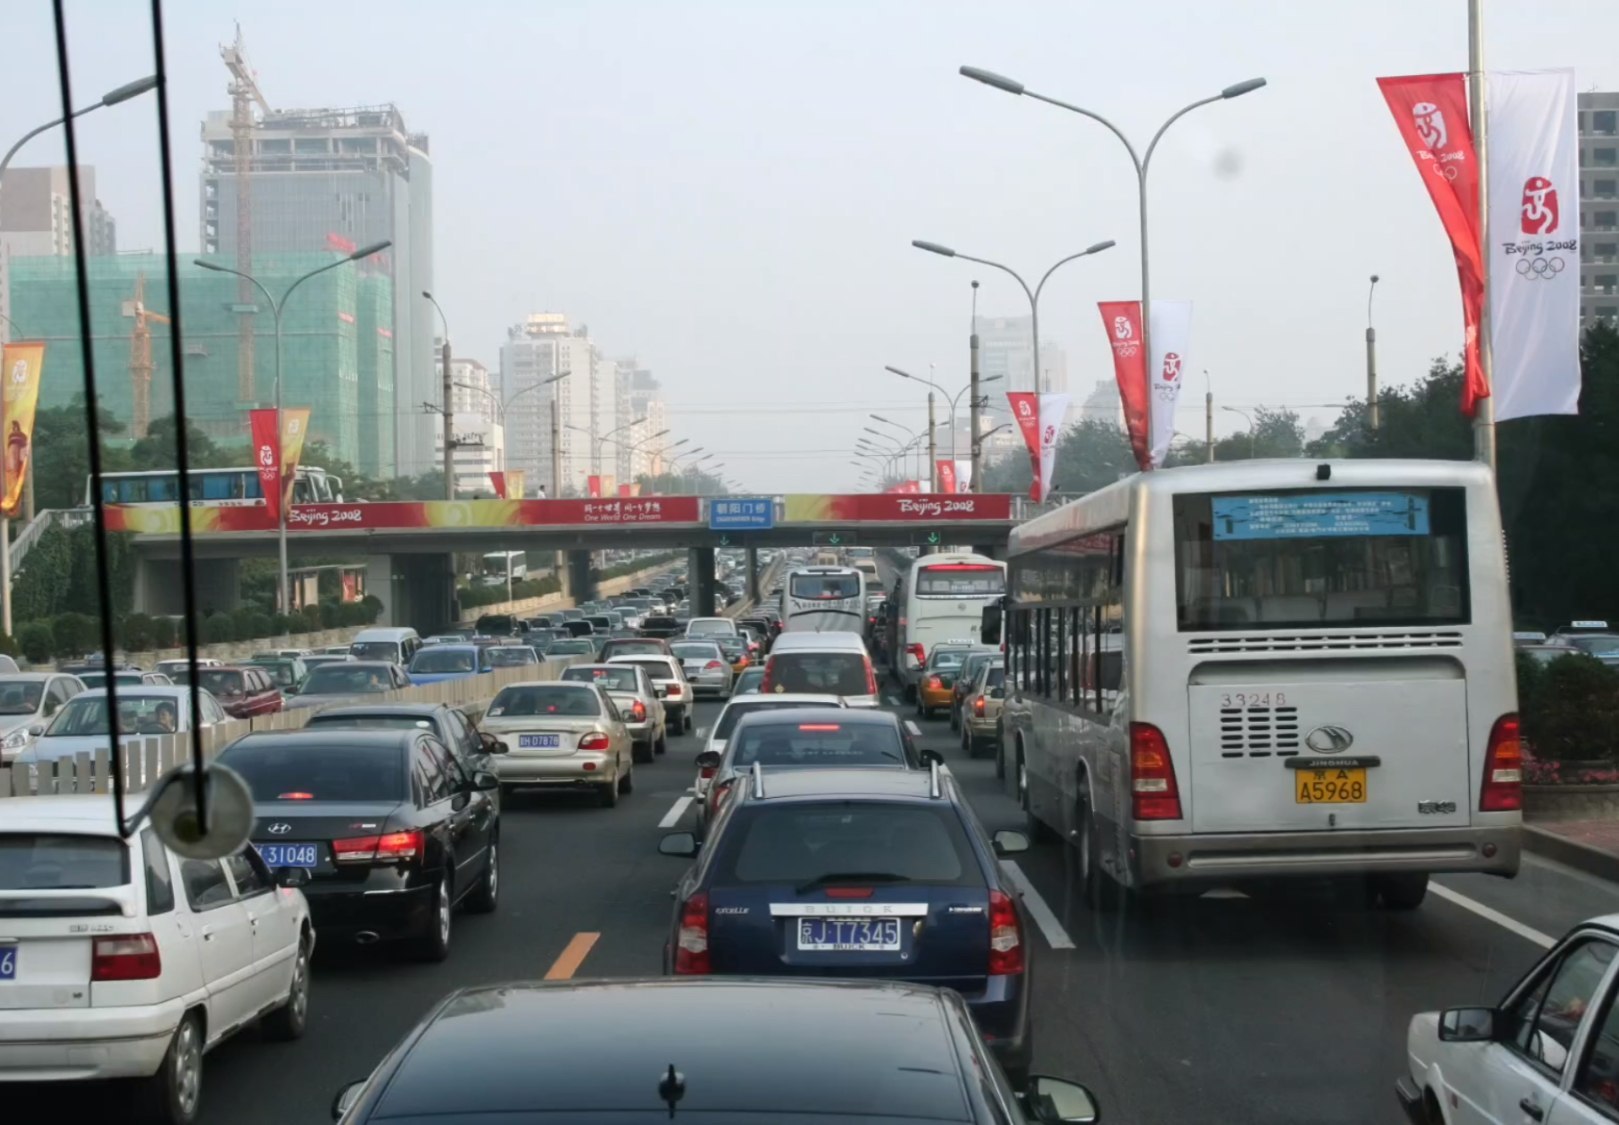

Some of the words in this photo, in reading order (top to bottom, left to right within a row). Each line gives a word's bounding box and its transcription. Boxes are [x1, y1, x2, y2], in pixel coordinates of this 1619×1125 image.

[1502, 240, 1543, 256] Beijing
[1546, 239, 1577, 251] 2008
[896, 499, 941, 515] Beijing
[944, 500, 975, 512] 2008
[289, 508, 329, 525] Beijing
[331, 509, 362, 521] 2008
[600, 513, 621, 521] World
[622, 513, 637, 521] One
[638, 512, 661, 520] Dream
[1220, 692, 1286, 707] 33248
[1300, 780, 1363, 801] A5968
[805, 905, 893, 913] BUICK
